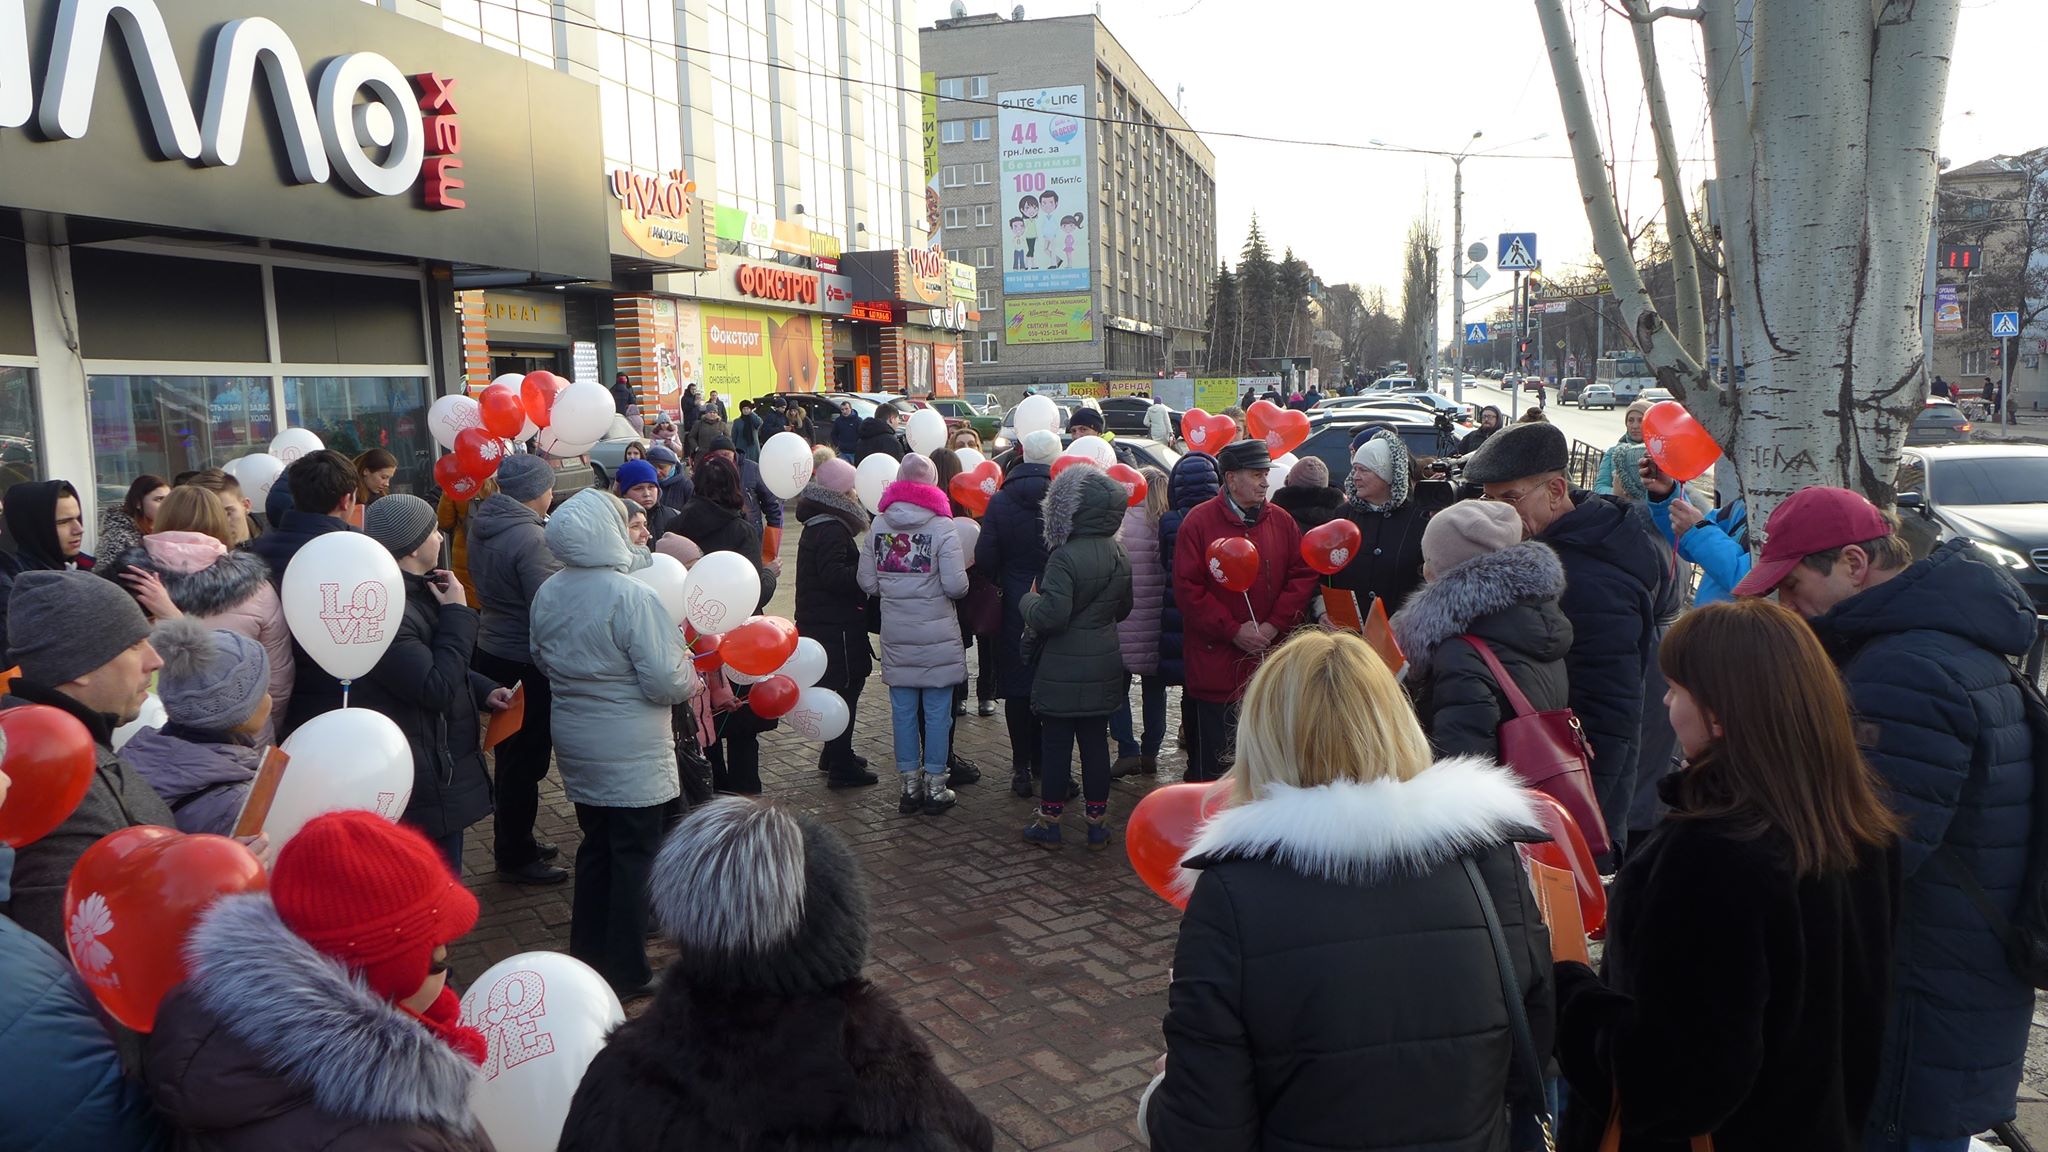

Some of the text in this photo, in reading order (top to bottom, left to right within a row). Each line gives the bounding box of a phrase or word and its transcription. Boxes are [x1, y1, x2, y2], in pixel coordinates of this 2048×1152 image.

[1011, 122, 1038, 144] 44
[1013, 172, 1045, 192] 100
[738, 264, 819, 304] ФОКСТРОТ
[484, 302, 541, 322] АРБАТ
[710, 324, 760, 349] Фокстрот
[1111, 382, 1151, 391] АРЕНДА
[320, 581, 387, 620] LO
[323, 616, 385, 645] VE
